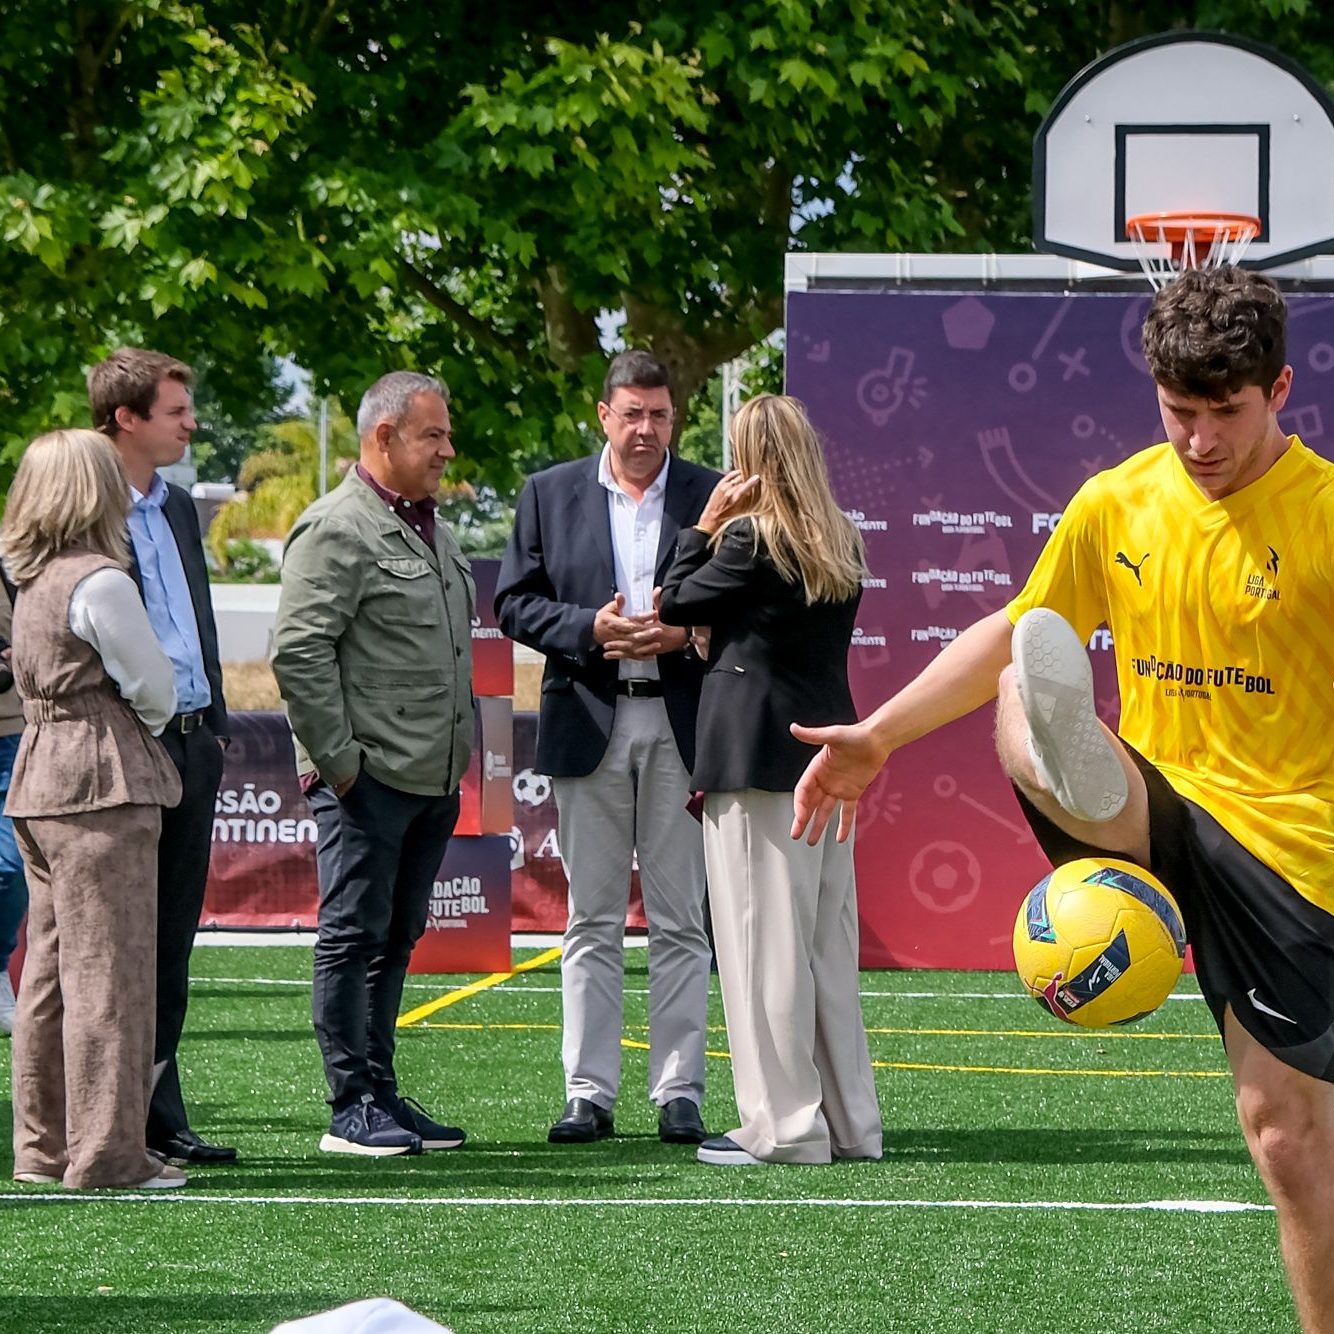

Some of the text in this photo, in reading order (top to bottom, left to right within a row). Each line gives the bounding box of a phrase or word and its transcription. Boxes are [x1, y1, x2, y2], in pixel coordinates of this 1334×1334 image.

[1245, 585, 1280, 600] PORTGAL
[1185, 668, 1203, 685] DO
[1207, 667, 1275, 694] FUTEBOL
